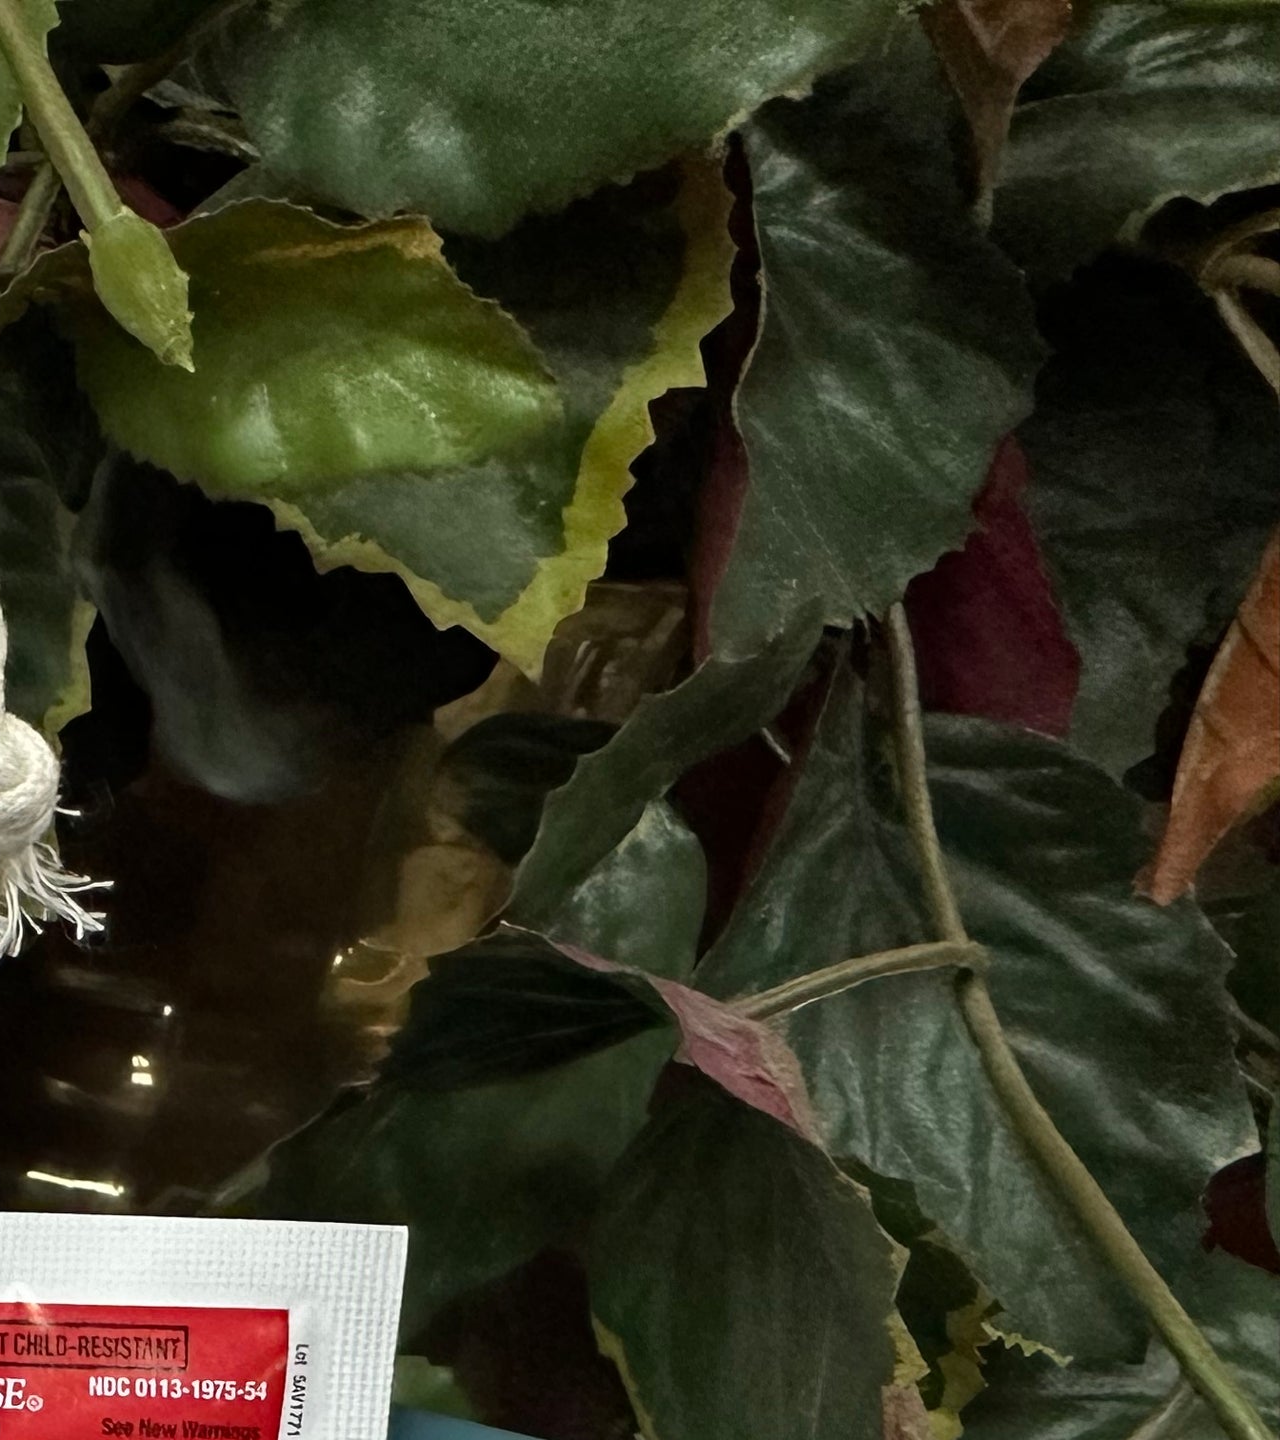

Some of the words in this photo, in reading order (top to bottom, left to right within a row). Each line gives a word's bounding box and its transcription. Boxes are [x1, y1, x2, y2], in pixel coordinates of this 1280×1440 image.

[13, 1332, 181, 1361] CHILD-RESISTANT
[89, 1376, 130, 1397] NDC
[136, 1377, 267, 1401] 0113-1975-54
[102, 1418, 133, 1438] See
[140, 1419, 177, 1439] New
